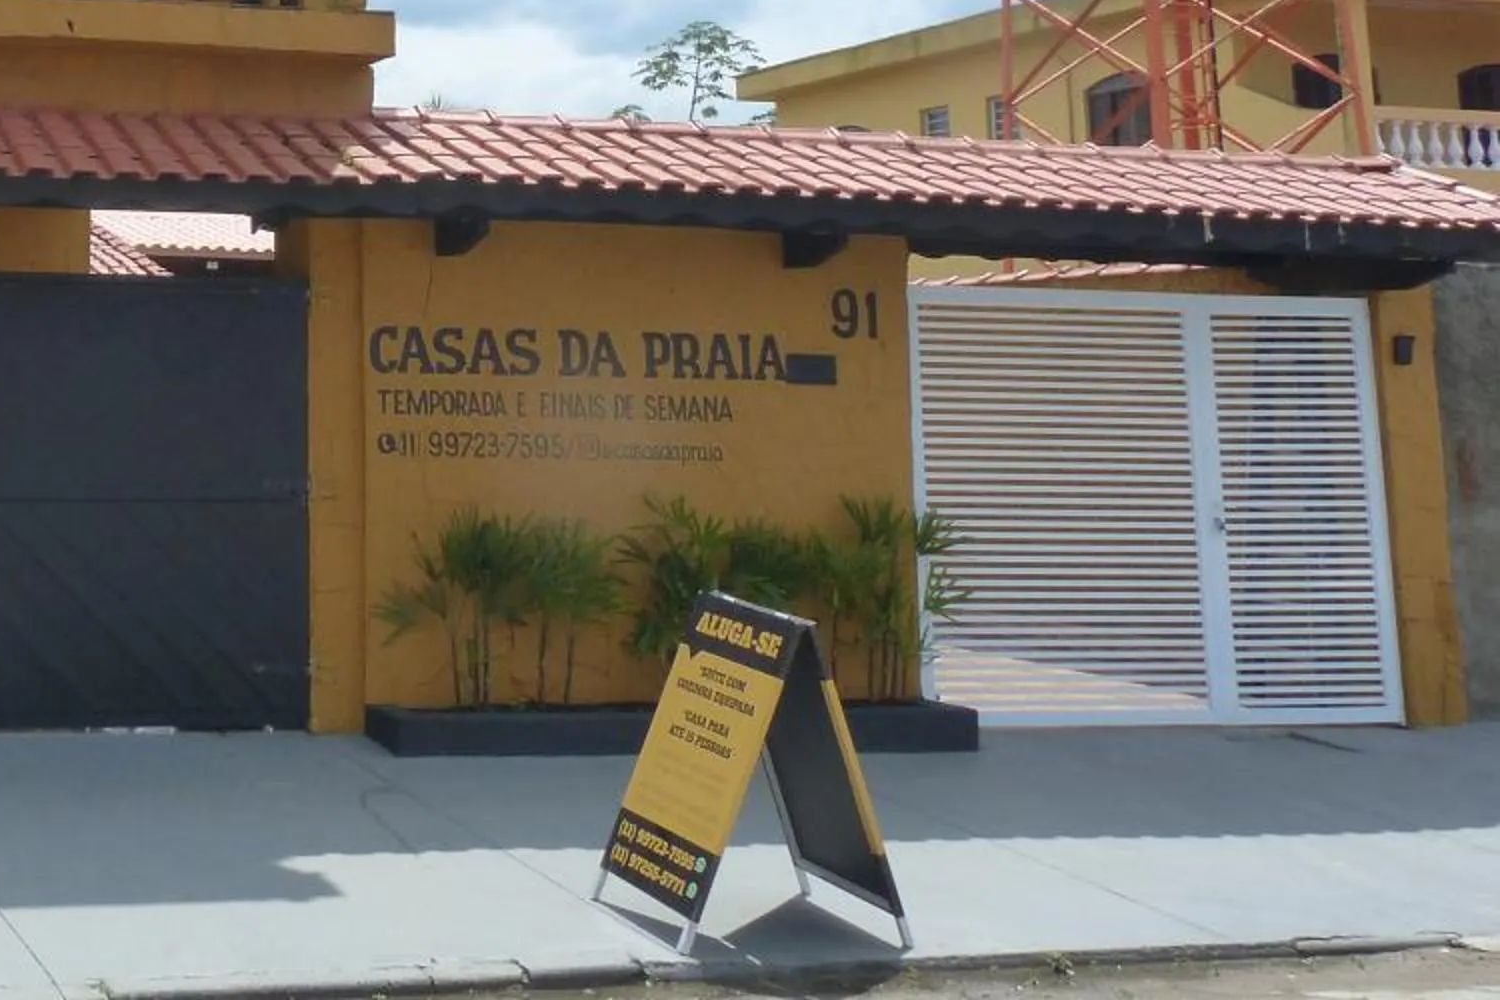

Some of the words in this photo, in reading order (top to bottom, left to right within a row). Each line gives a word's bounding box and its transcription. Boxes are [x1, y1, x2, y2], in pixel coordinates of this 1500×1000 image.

[832, 288, 878, 340] 91
[369, 325, 541, 377] CASAS
[557, 328, 626, 378] DA
[642, 331, 787, 381] PRAIA
[377, 389, 508, 418] TEMPORADA
[516, 391, 527, 418] E
[613, 394, 635, 421] DE
[644, 393, 733, 423] SEMANA
[695, 611, 784, 660] ALUGA-SE
